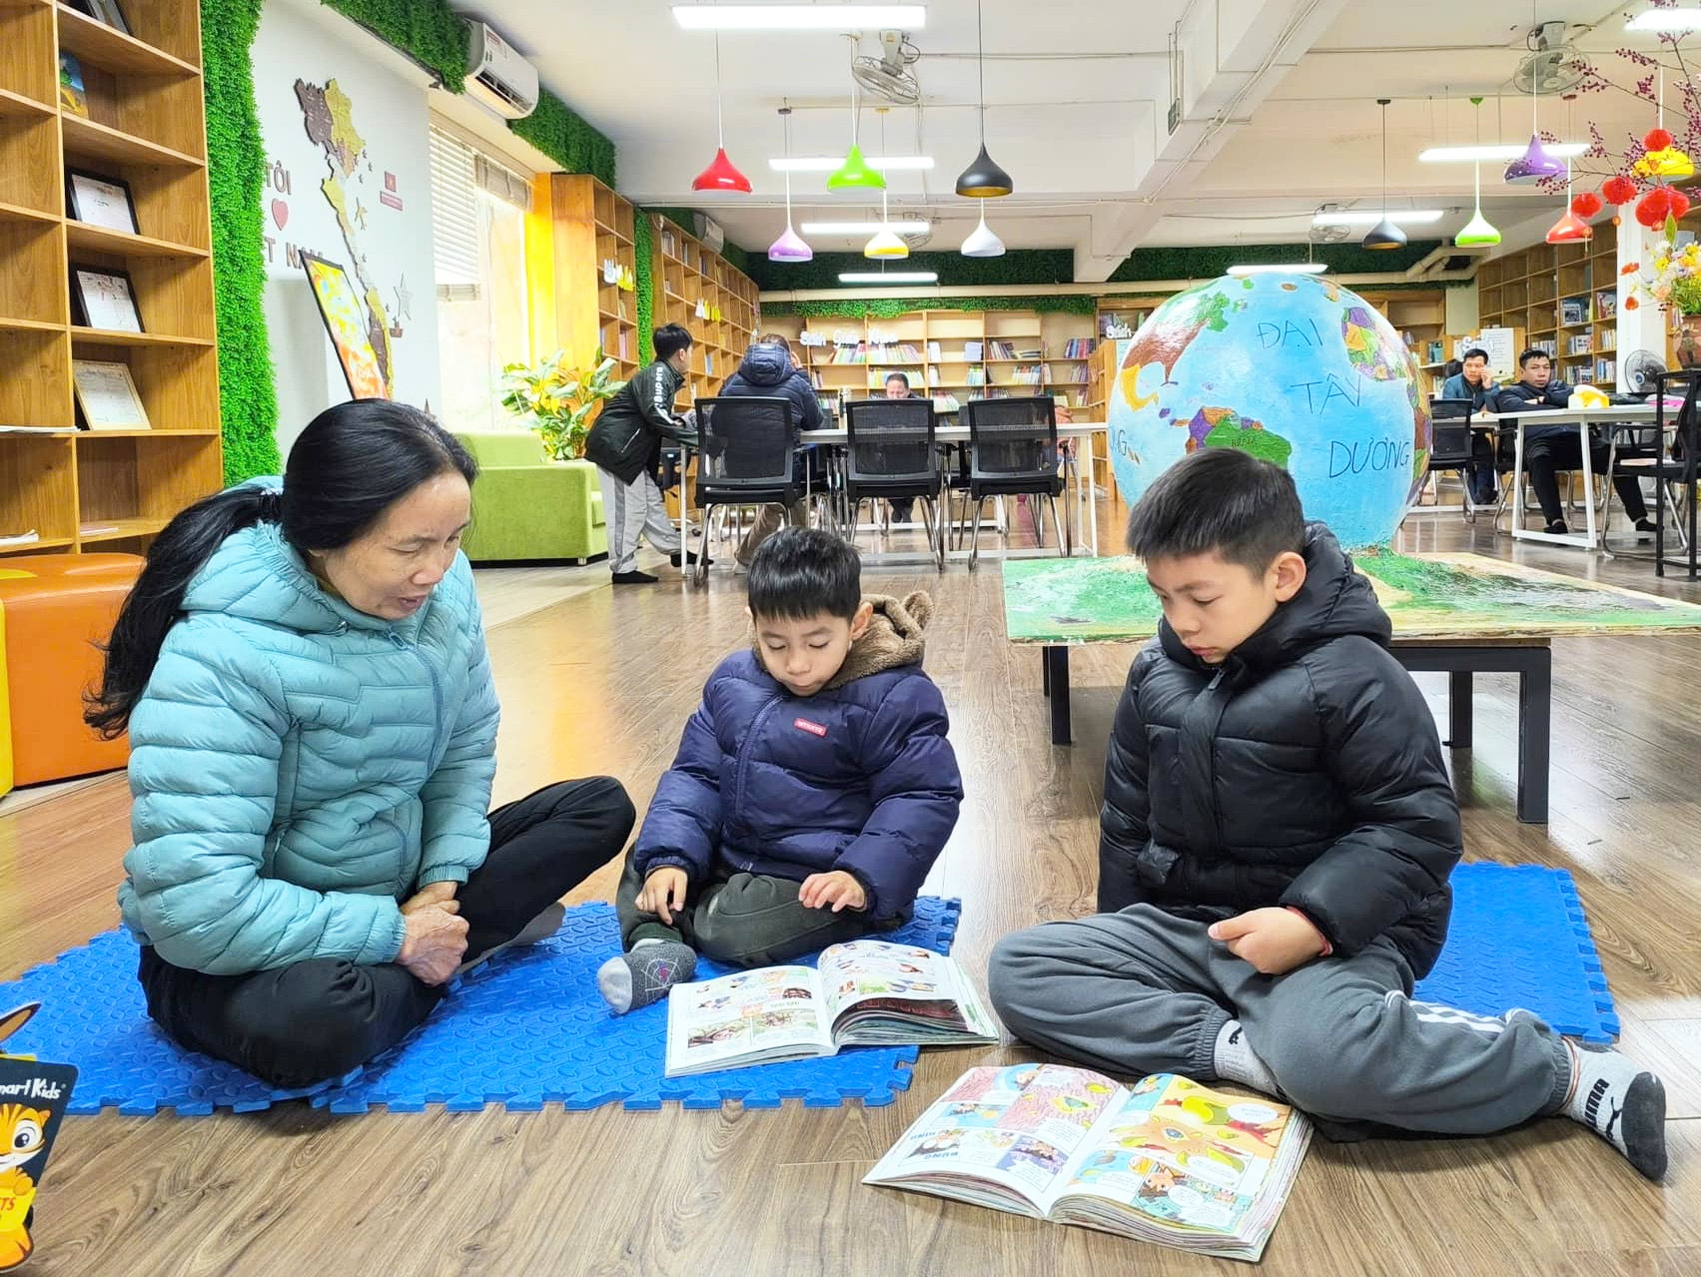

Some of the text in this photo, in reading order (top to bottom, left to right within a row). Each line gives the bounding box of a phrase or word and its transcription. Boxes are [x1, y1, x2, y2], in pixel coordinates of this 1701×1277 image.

[264, 160, 291, 195] TÔI
[1257, 318, 1323, 350] ĐẠI
[1290, 372, 1362, 415] TÂY
[1329, 437, 1410, 478] DƯƠNG
[31, 1078, 61, 1100] Kids
